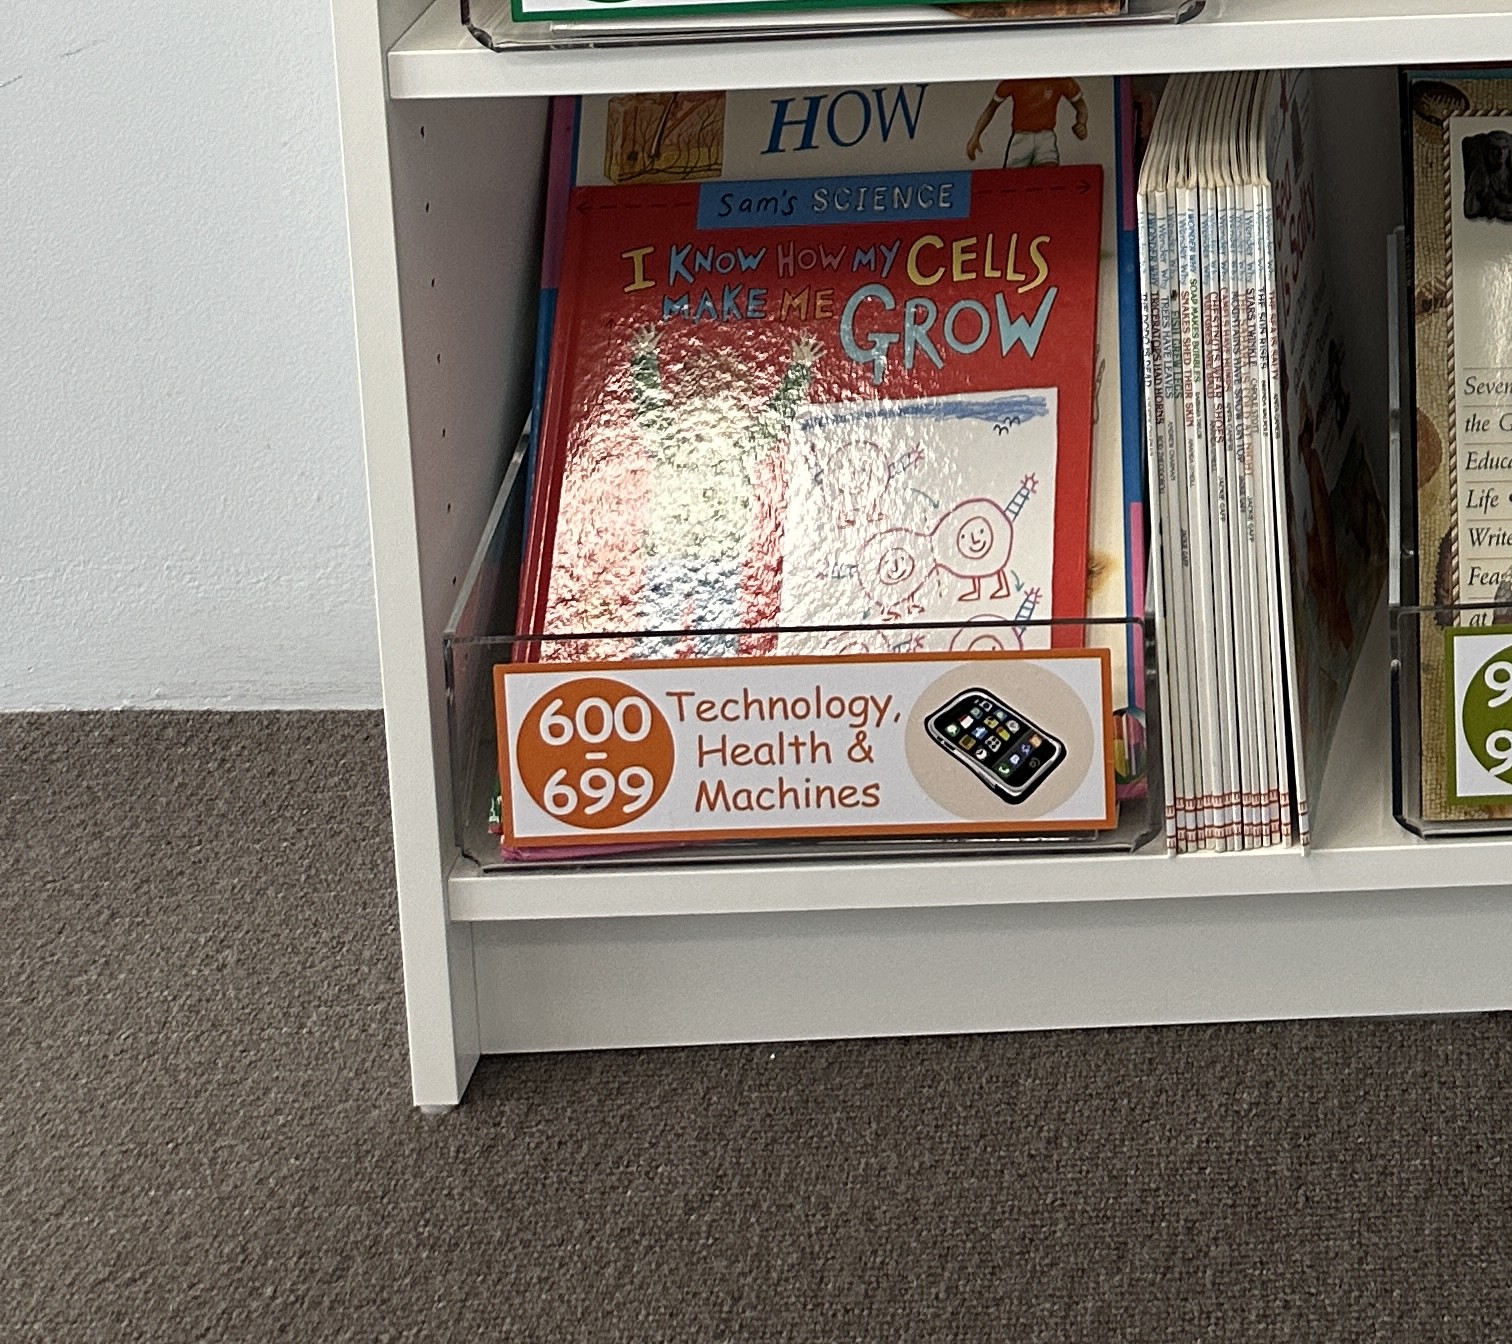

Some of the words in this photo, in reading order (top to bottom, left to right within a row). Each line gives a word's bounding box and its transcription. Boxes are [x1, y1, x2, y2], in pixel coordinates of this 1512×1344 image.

[760, 83, 929, 155] HOW
[812, 182, 955, 214] SCIENCE
[622, 246, 655, 293] I
[668, 243, 766, 286] KNOW
[776, 240, 847, 278] HOW
[852, 240, 901, 279] MY
[906, 232, 1051, 294] CELLS
[1190, 278, 1199, 305] SOAP
[1246, 288, 1256, 321] STARS
[1150, 291, 1161, 361] TRICERATOPS
[1160, 296, 1171, 327] TREES
[1181, 290, 1191, 333] SNAKES
[1191, 306, 1200, 339] MAKES
[662, 284, 768, 323] MAKE
[780, 285, 837, 322] ME
[839, 283, 1059, 386] GROW
[1162, 330, 1172, 358] HAVE
[1183, 337, 1192, 365] SHED
[1247, 324, 1258, 367] TWINKLE
[1164, 360, 1173, 399] LEAVES
[1192, 341, 1202, 383] BUBBLES
[1184, 370, 1194, 399] THEIR
[1155, 387, 1165, 425] HORNS
[1185, 402, 1195, 427] SKIN
[1464, 413, 1491, 433] the
[1465, 486, 1500, 514] Life
[538, 695, 652, 746] 600
[665, 685, 902, 729] Technology,
[697, 730, 832, 768] Health
[846, 730, 875, 764] &
[543, 766, 654, 815] 699
[695, 776, 881, 813] Machines
